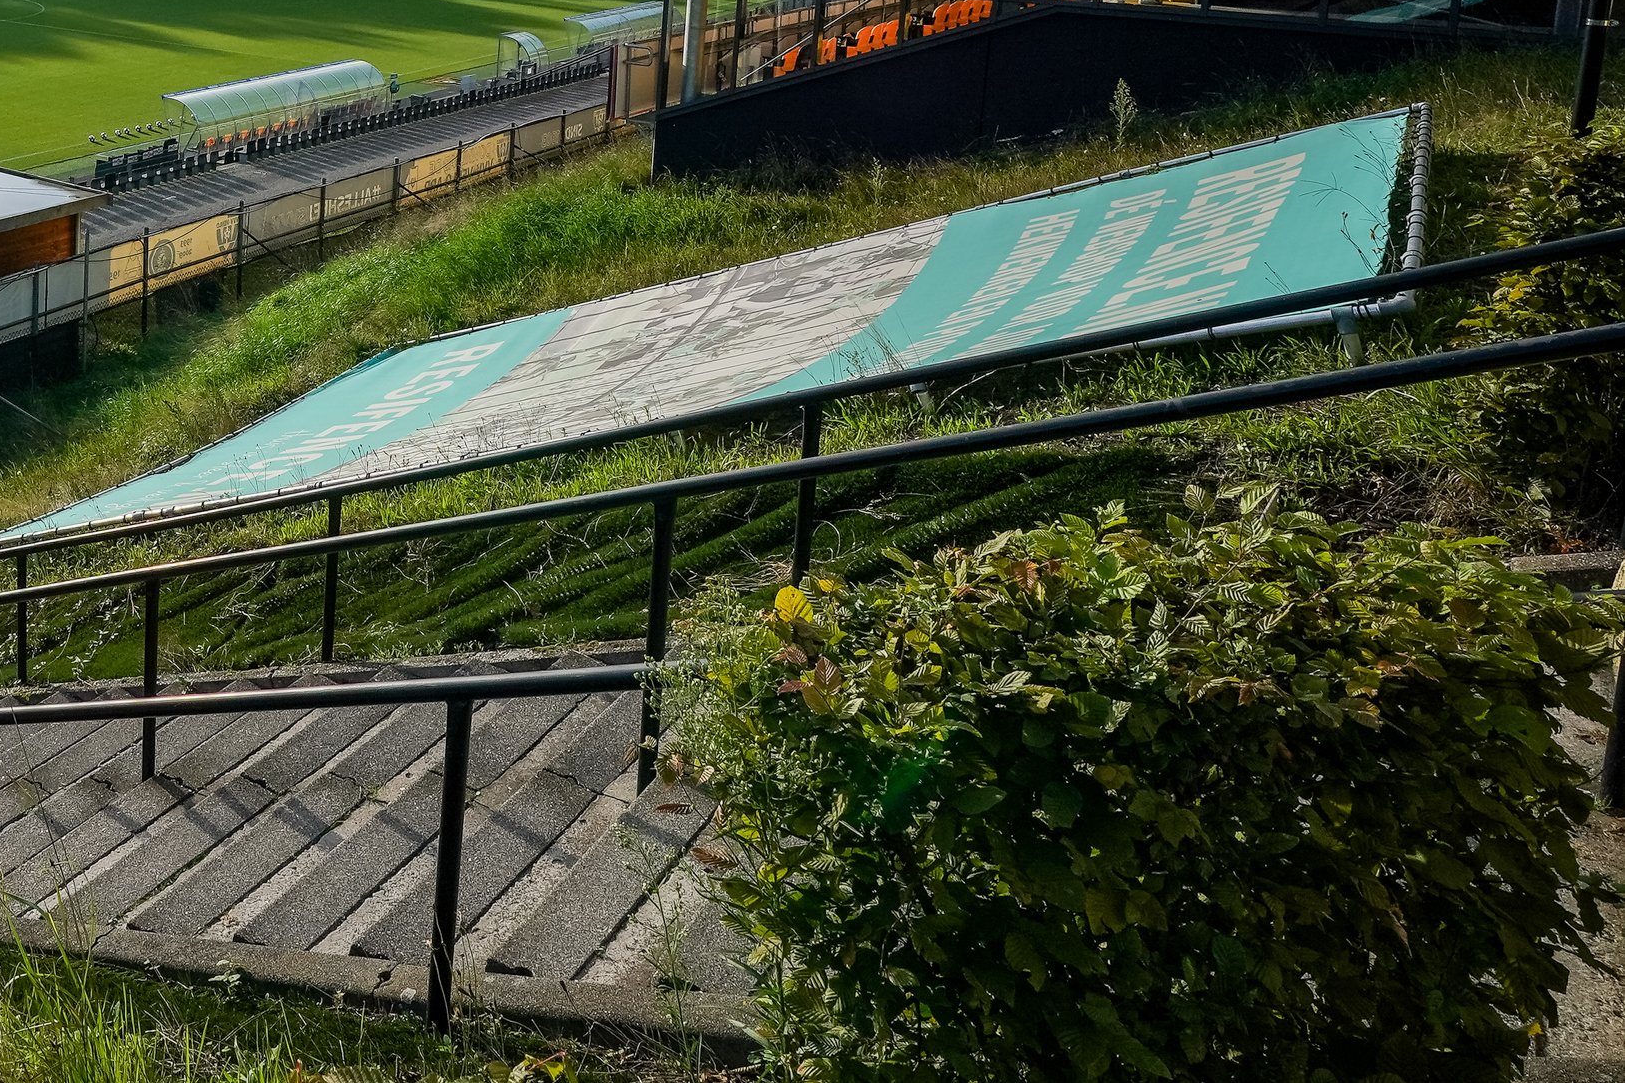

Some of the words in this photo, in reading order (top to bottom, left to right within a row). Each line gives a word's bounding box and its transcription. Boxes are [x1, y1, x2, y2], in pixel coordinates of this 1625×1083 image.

[1102, 188, 1176, 220] DÉ
[961, 208, 1080, 307] HEKWERKEN
[1051, 211, 1158, 285] WEBSHOP
[935, 298, 1010, 327] EN
[994, 277, 1104, 331] VOOR
